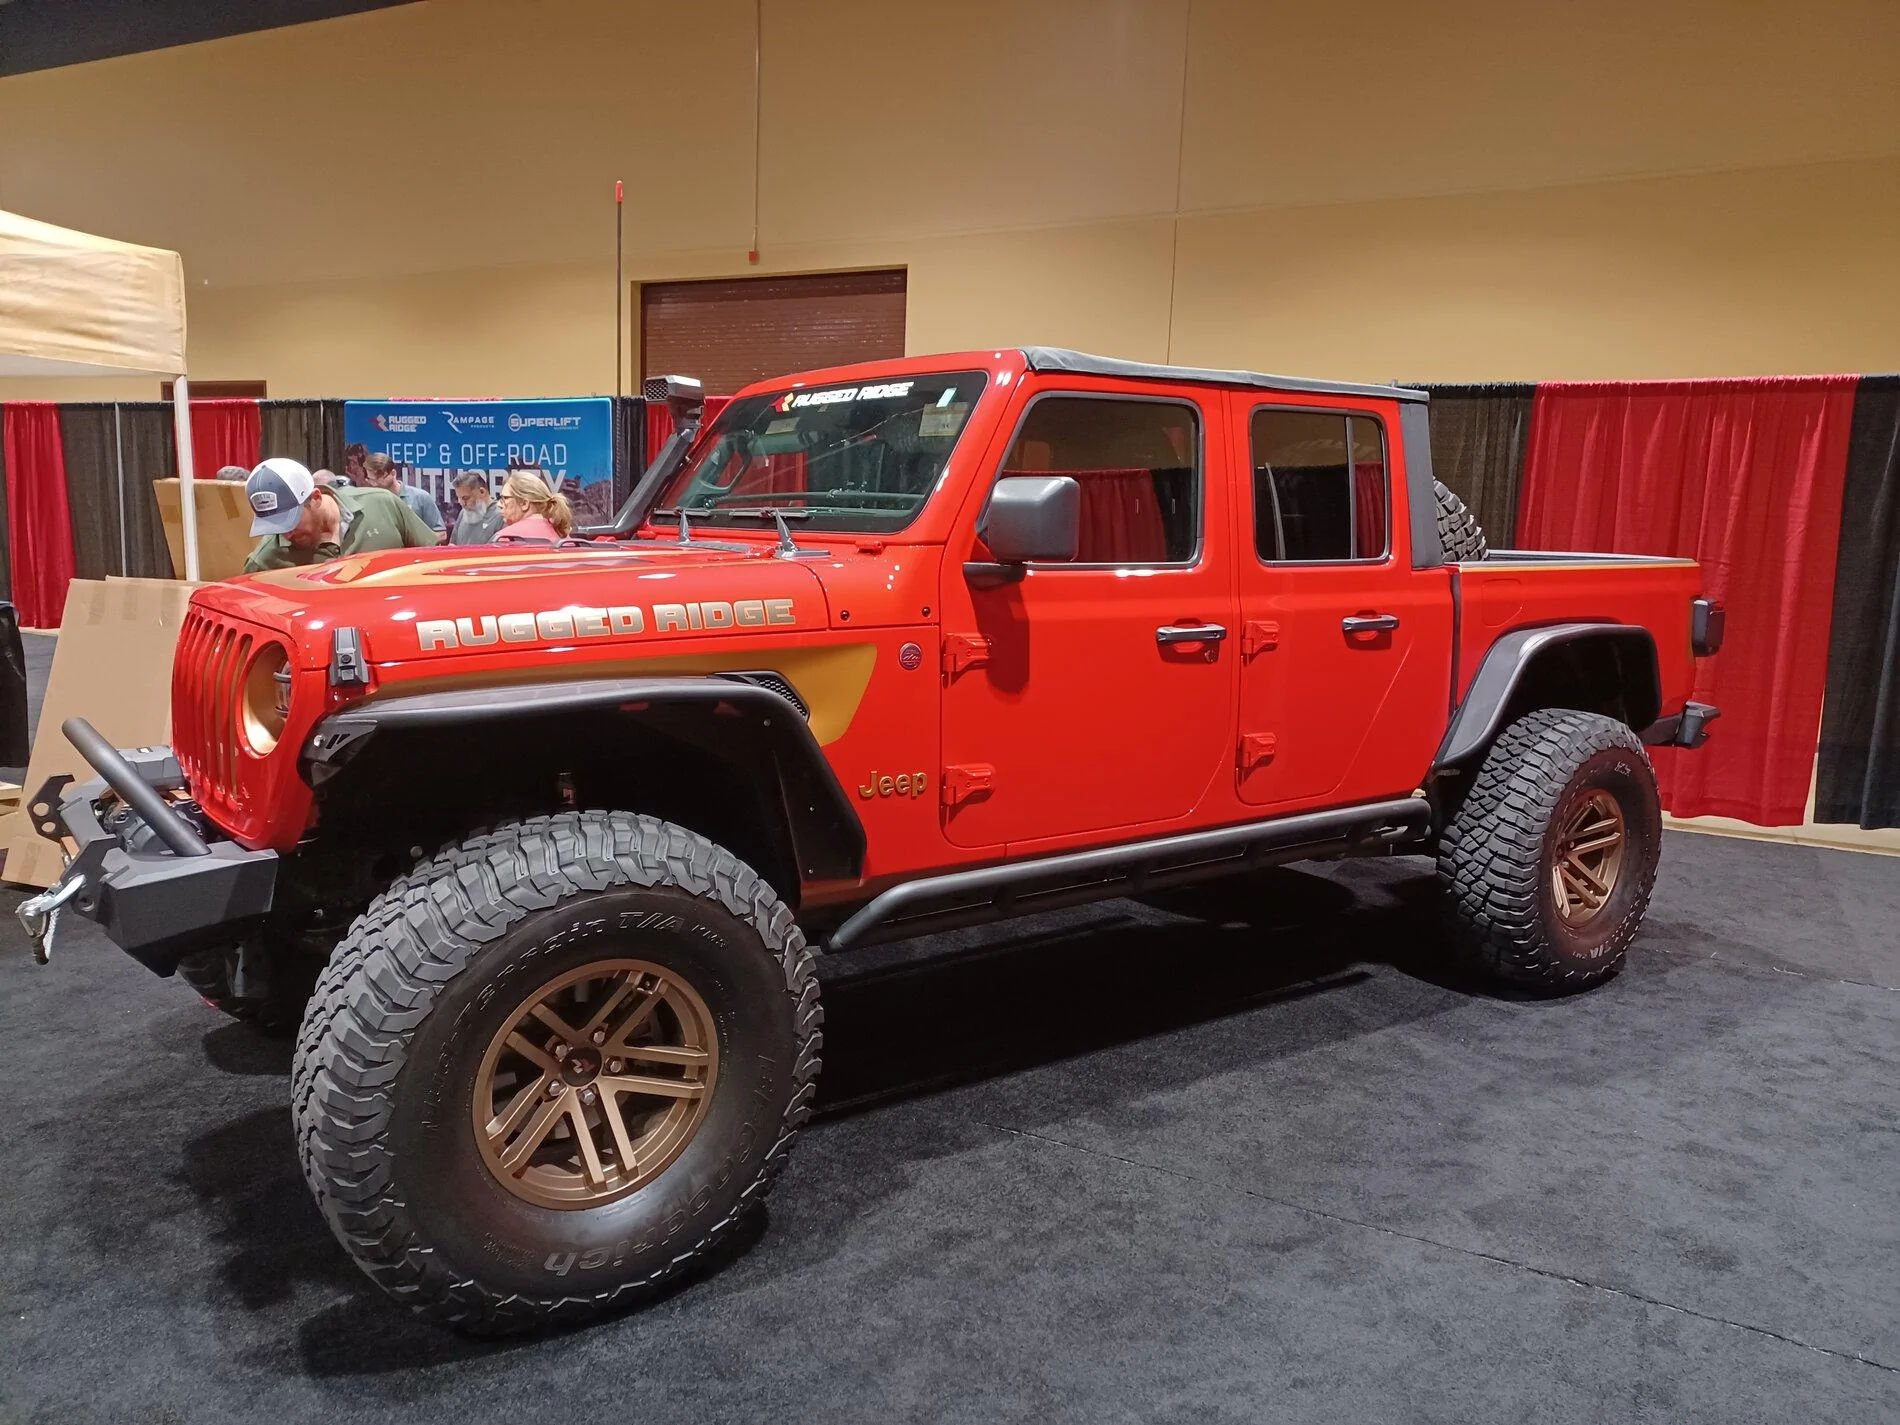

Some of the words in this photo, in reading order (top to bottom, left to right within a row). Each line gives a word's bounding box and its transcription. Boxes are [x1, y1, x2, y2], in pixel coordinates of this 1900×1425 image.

[856, 381, 914, 401] RIDGE
[388, 415, 427, 425] RUGGED
[388, 424, 418, 433] RIDGE
[441, 411, 495, 433] RAMPAGE
[508, 414, 581, 430] SUPERLIFT
[439, 443, 451, 465] &
[461, 443, 567, 466] OFF-ROAD
[416, 605, 644, 651] RUGGED
[652, 598, 796, 633] RIDGE
[858, 770, 929, 799] Jeep
